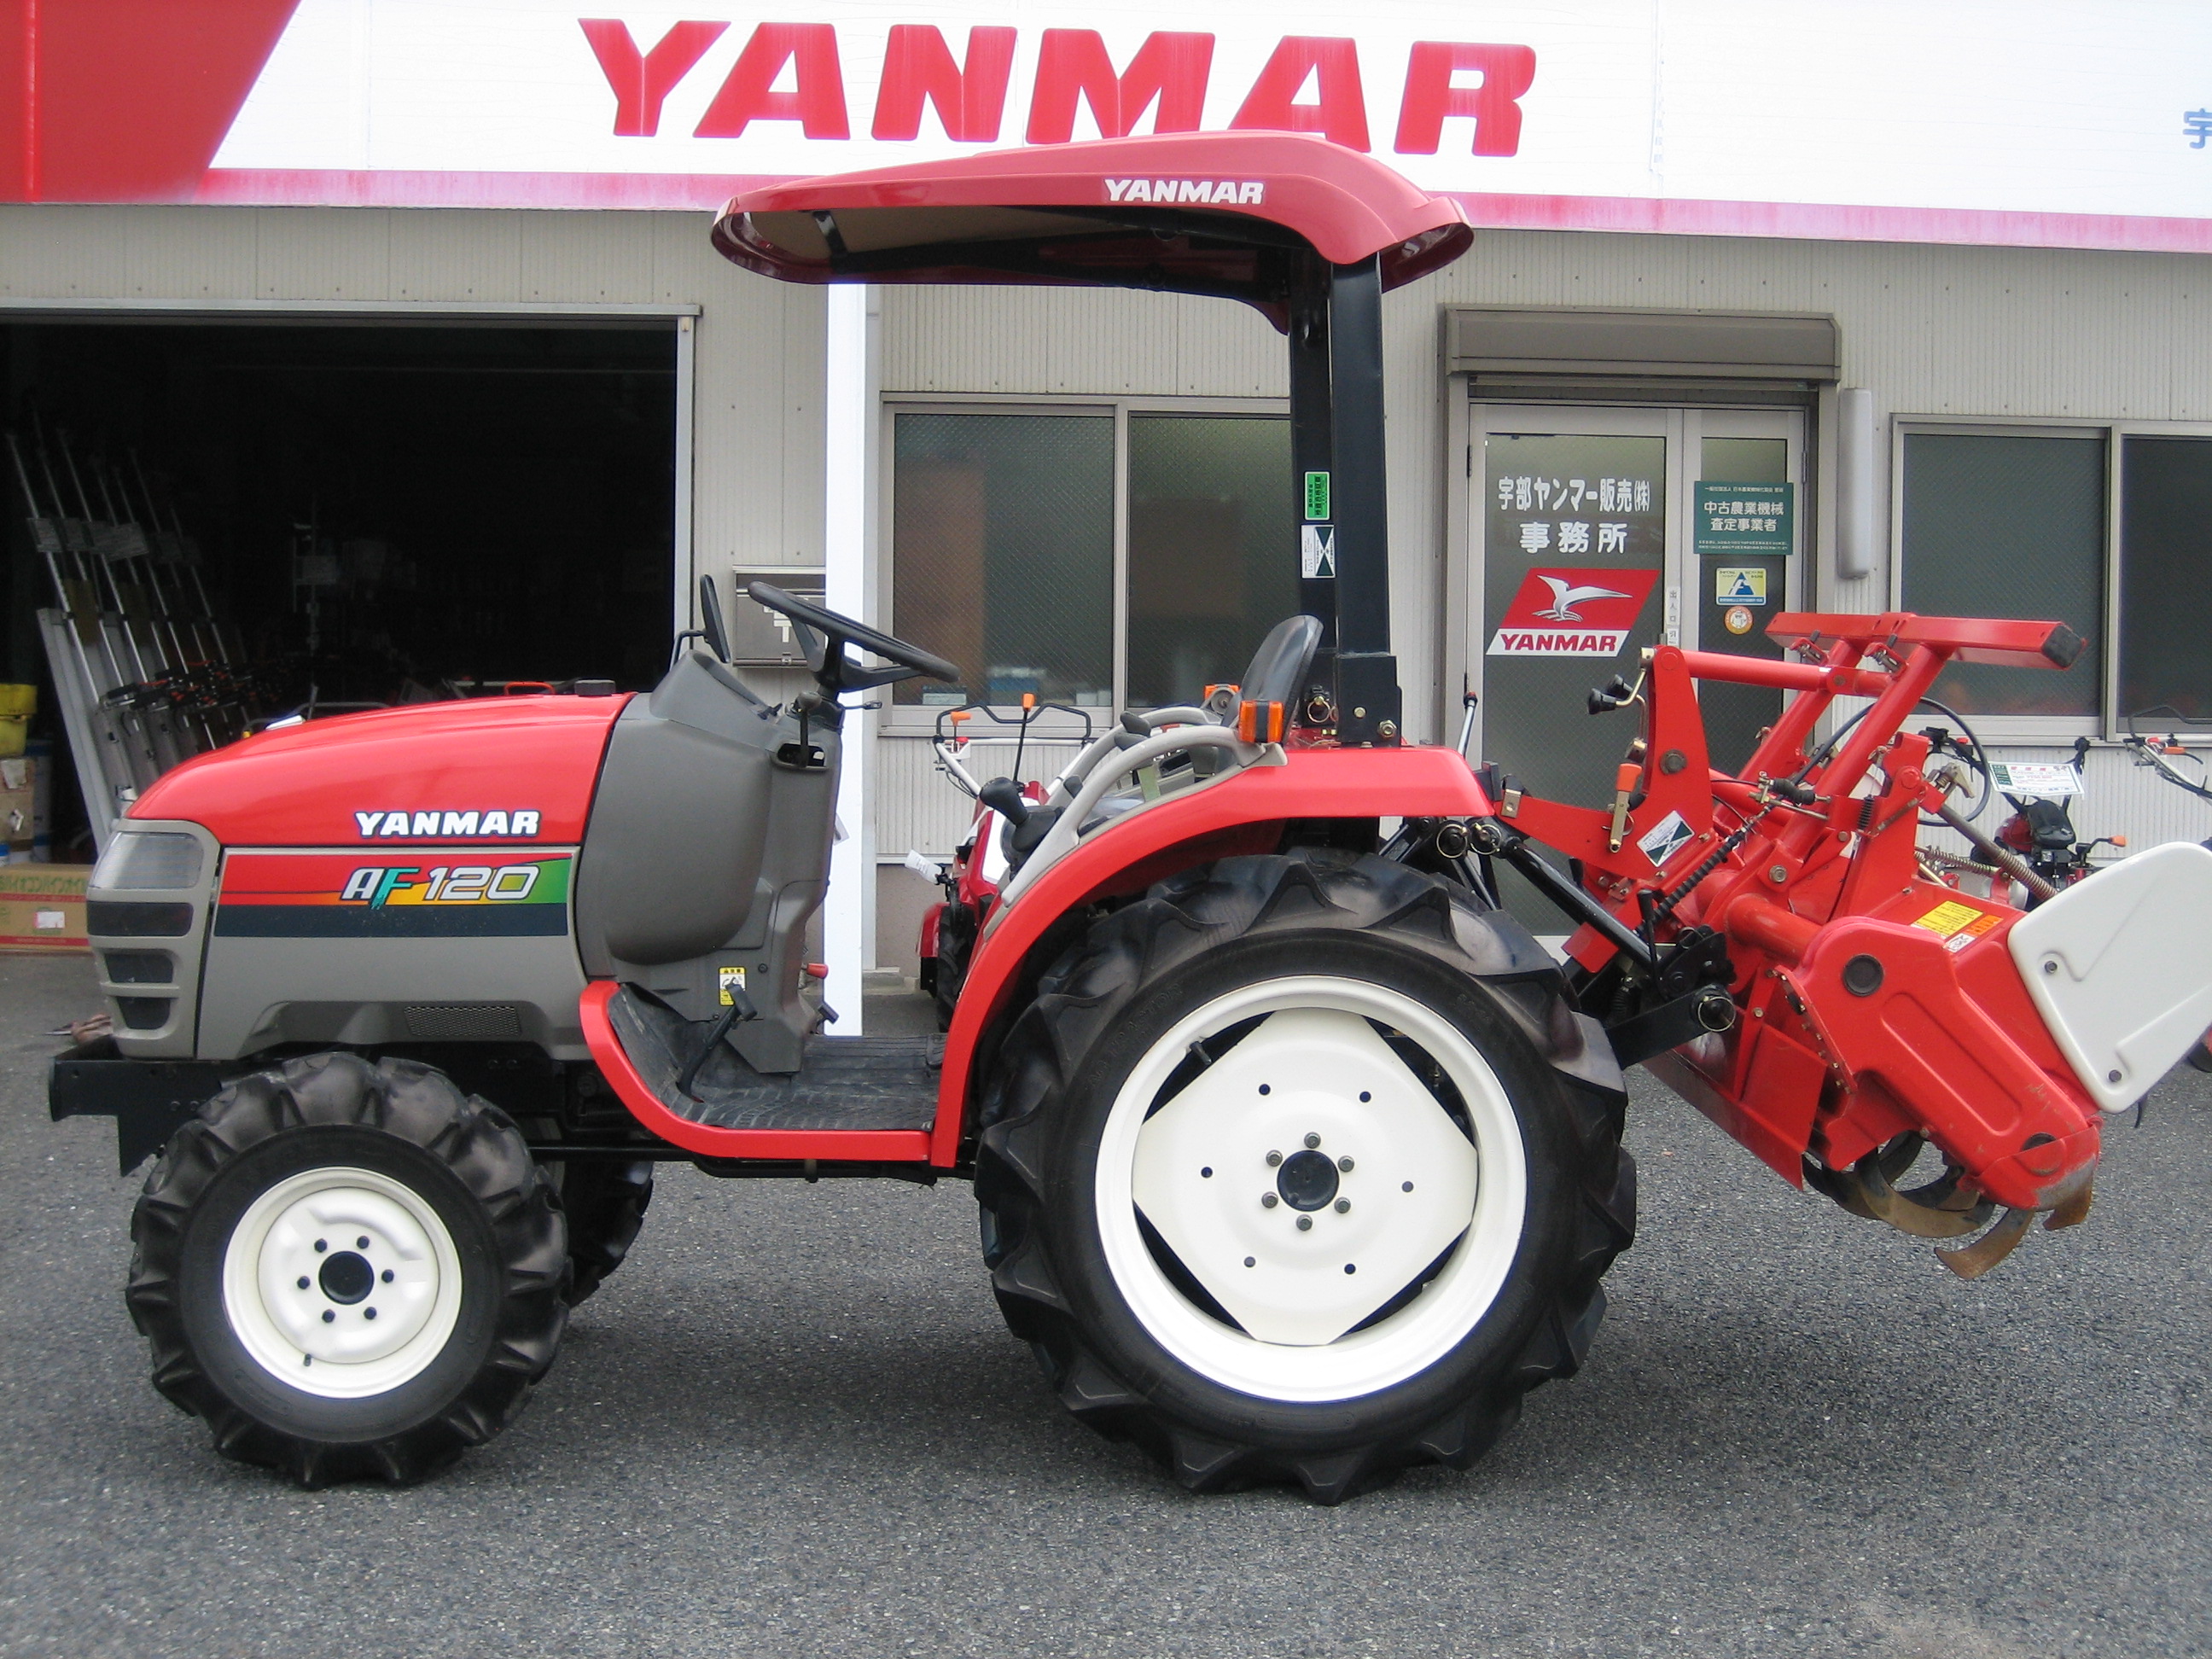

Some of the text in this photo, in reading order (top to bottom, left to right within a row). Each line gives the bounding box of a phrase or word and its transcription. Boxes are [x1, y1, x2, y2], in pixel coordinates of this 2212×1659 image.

[578, 17, 1536, 156] YANMAR
[1103, 178, 1265, 205] YANMAR
[1703, 501, 1784, 515] 中古農業機械
[1519, 521, 1628, 553] 事務所
[1710, 517, 1777, 532] 査定事業者
[1500, 633, 1617, 652] YANMAR
[354, 809, 540, 837] YANMAR
